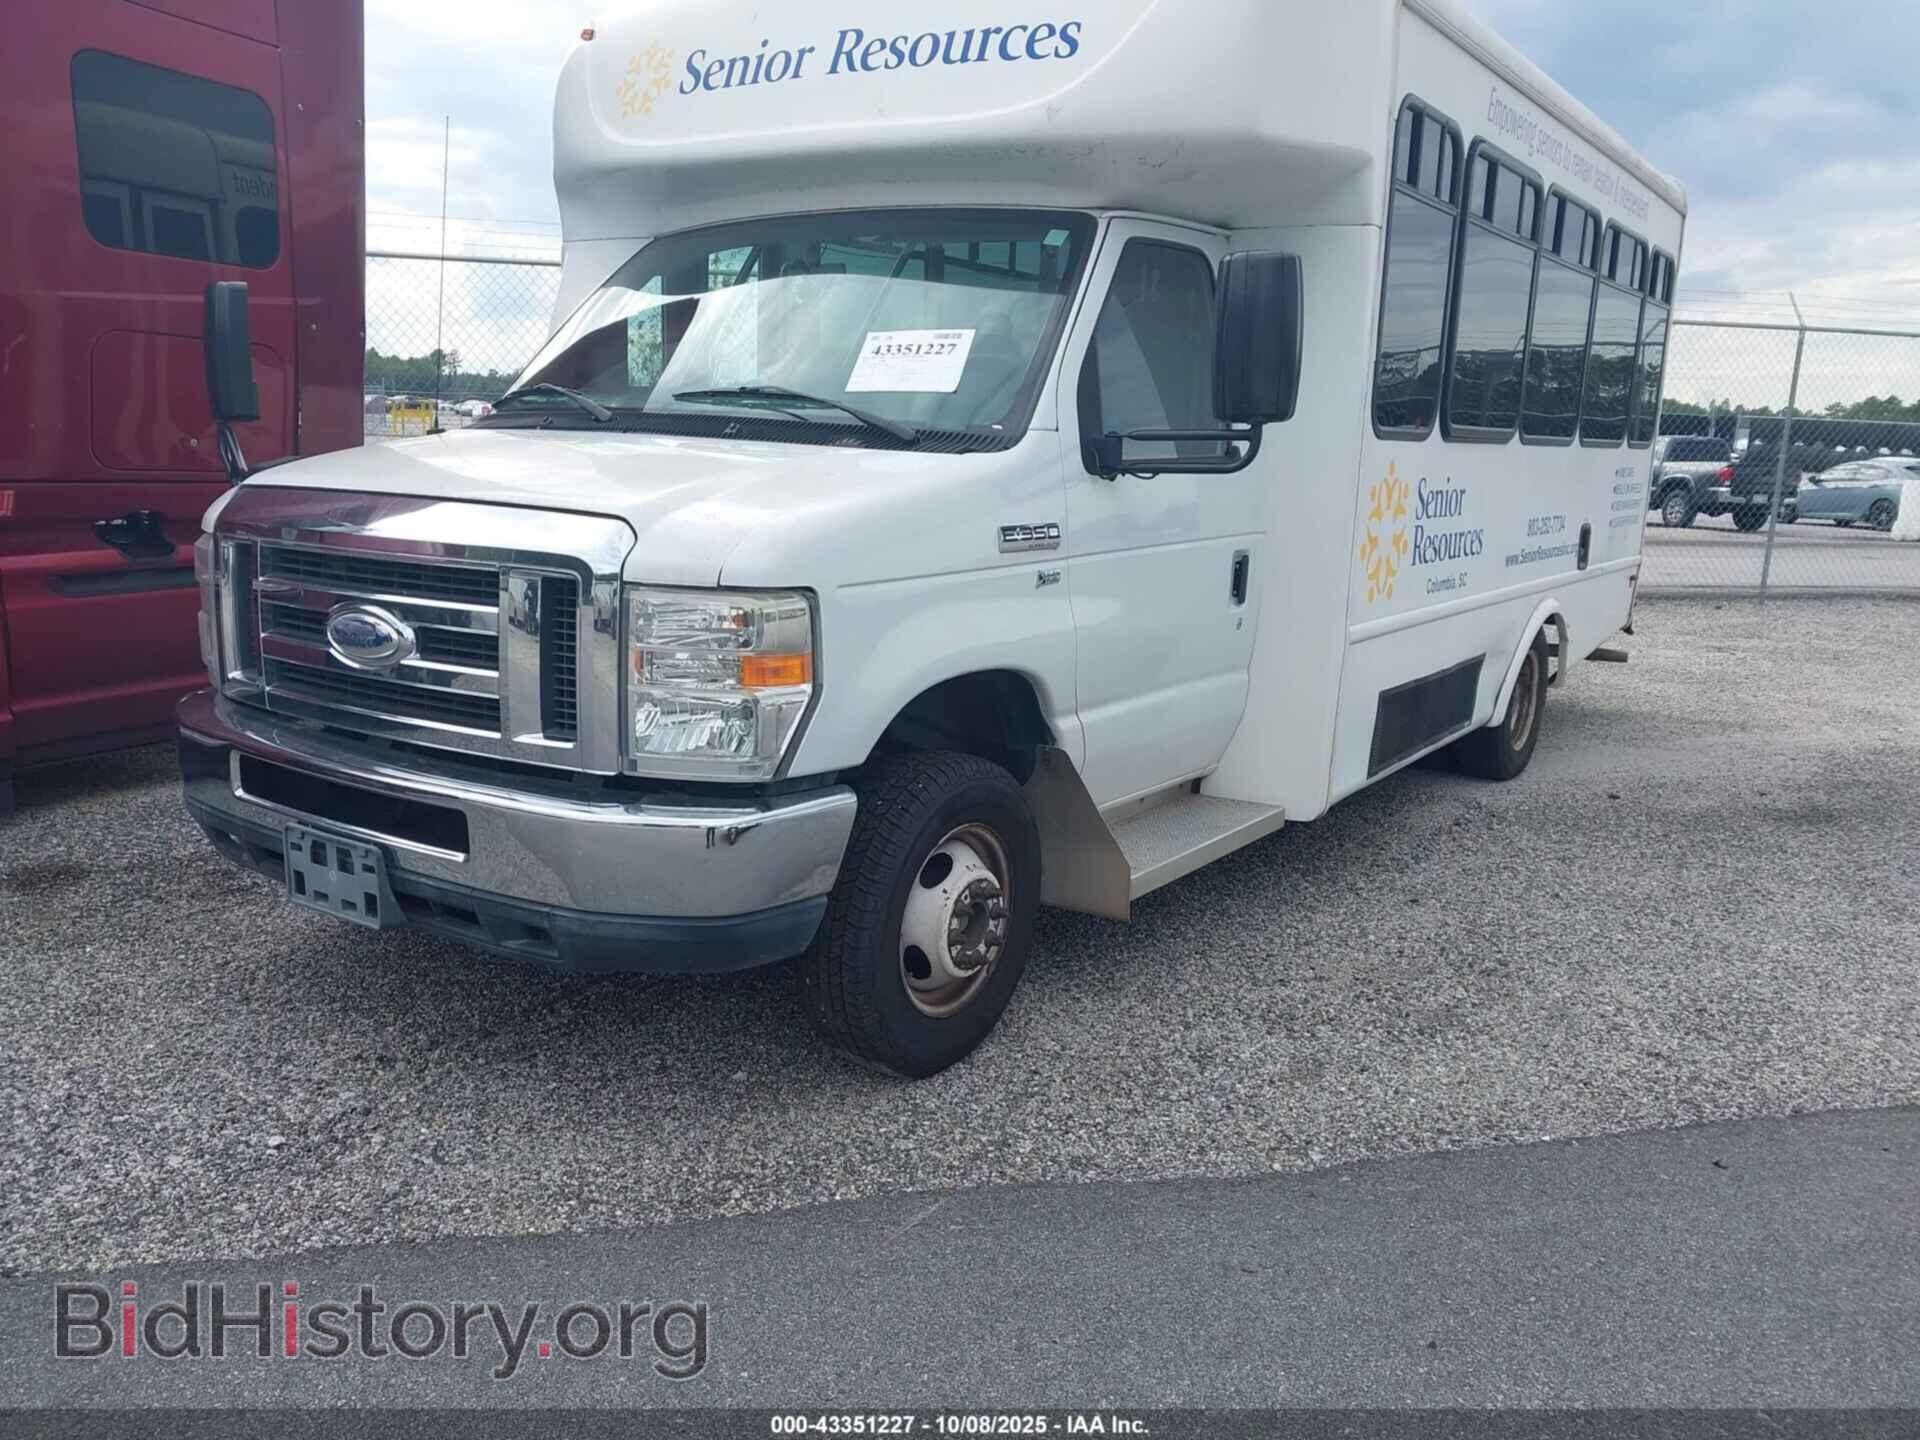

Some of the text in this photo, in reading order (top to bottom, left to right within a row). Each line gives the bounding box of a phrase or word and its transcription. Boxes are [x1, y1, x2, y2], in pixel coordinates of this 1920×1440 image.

[679, 21, 1082, 95] Senior Resources
[871, 343, 958, 356] 43351227
[1415, 476, 1466, 521] Senior
[1411, 524, 1484, 566] Resources
